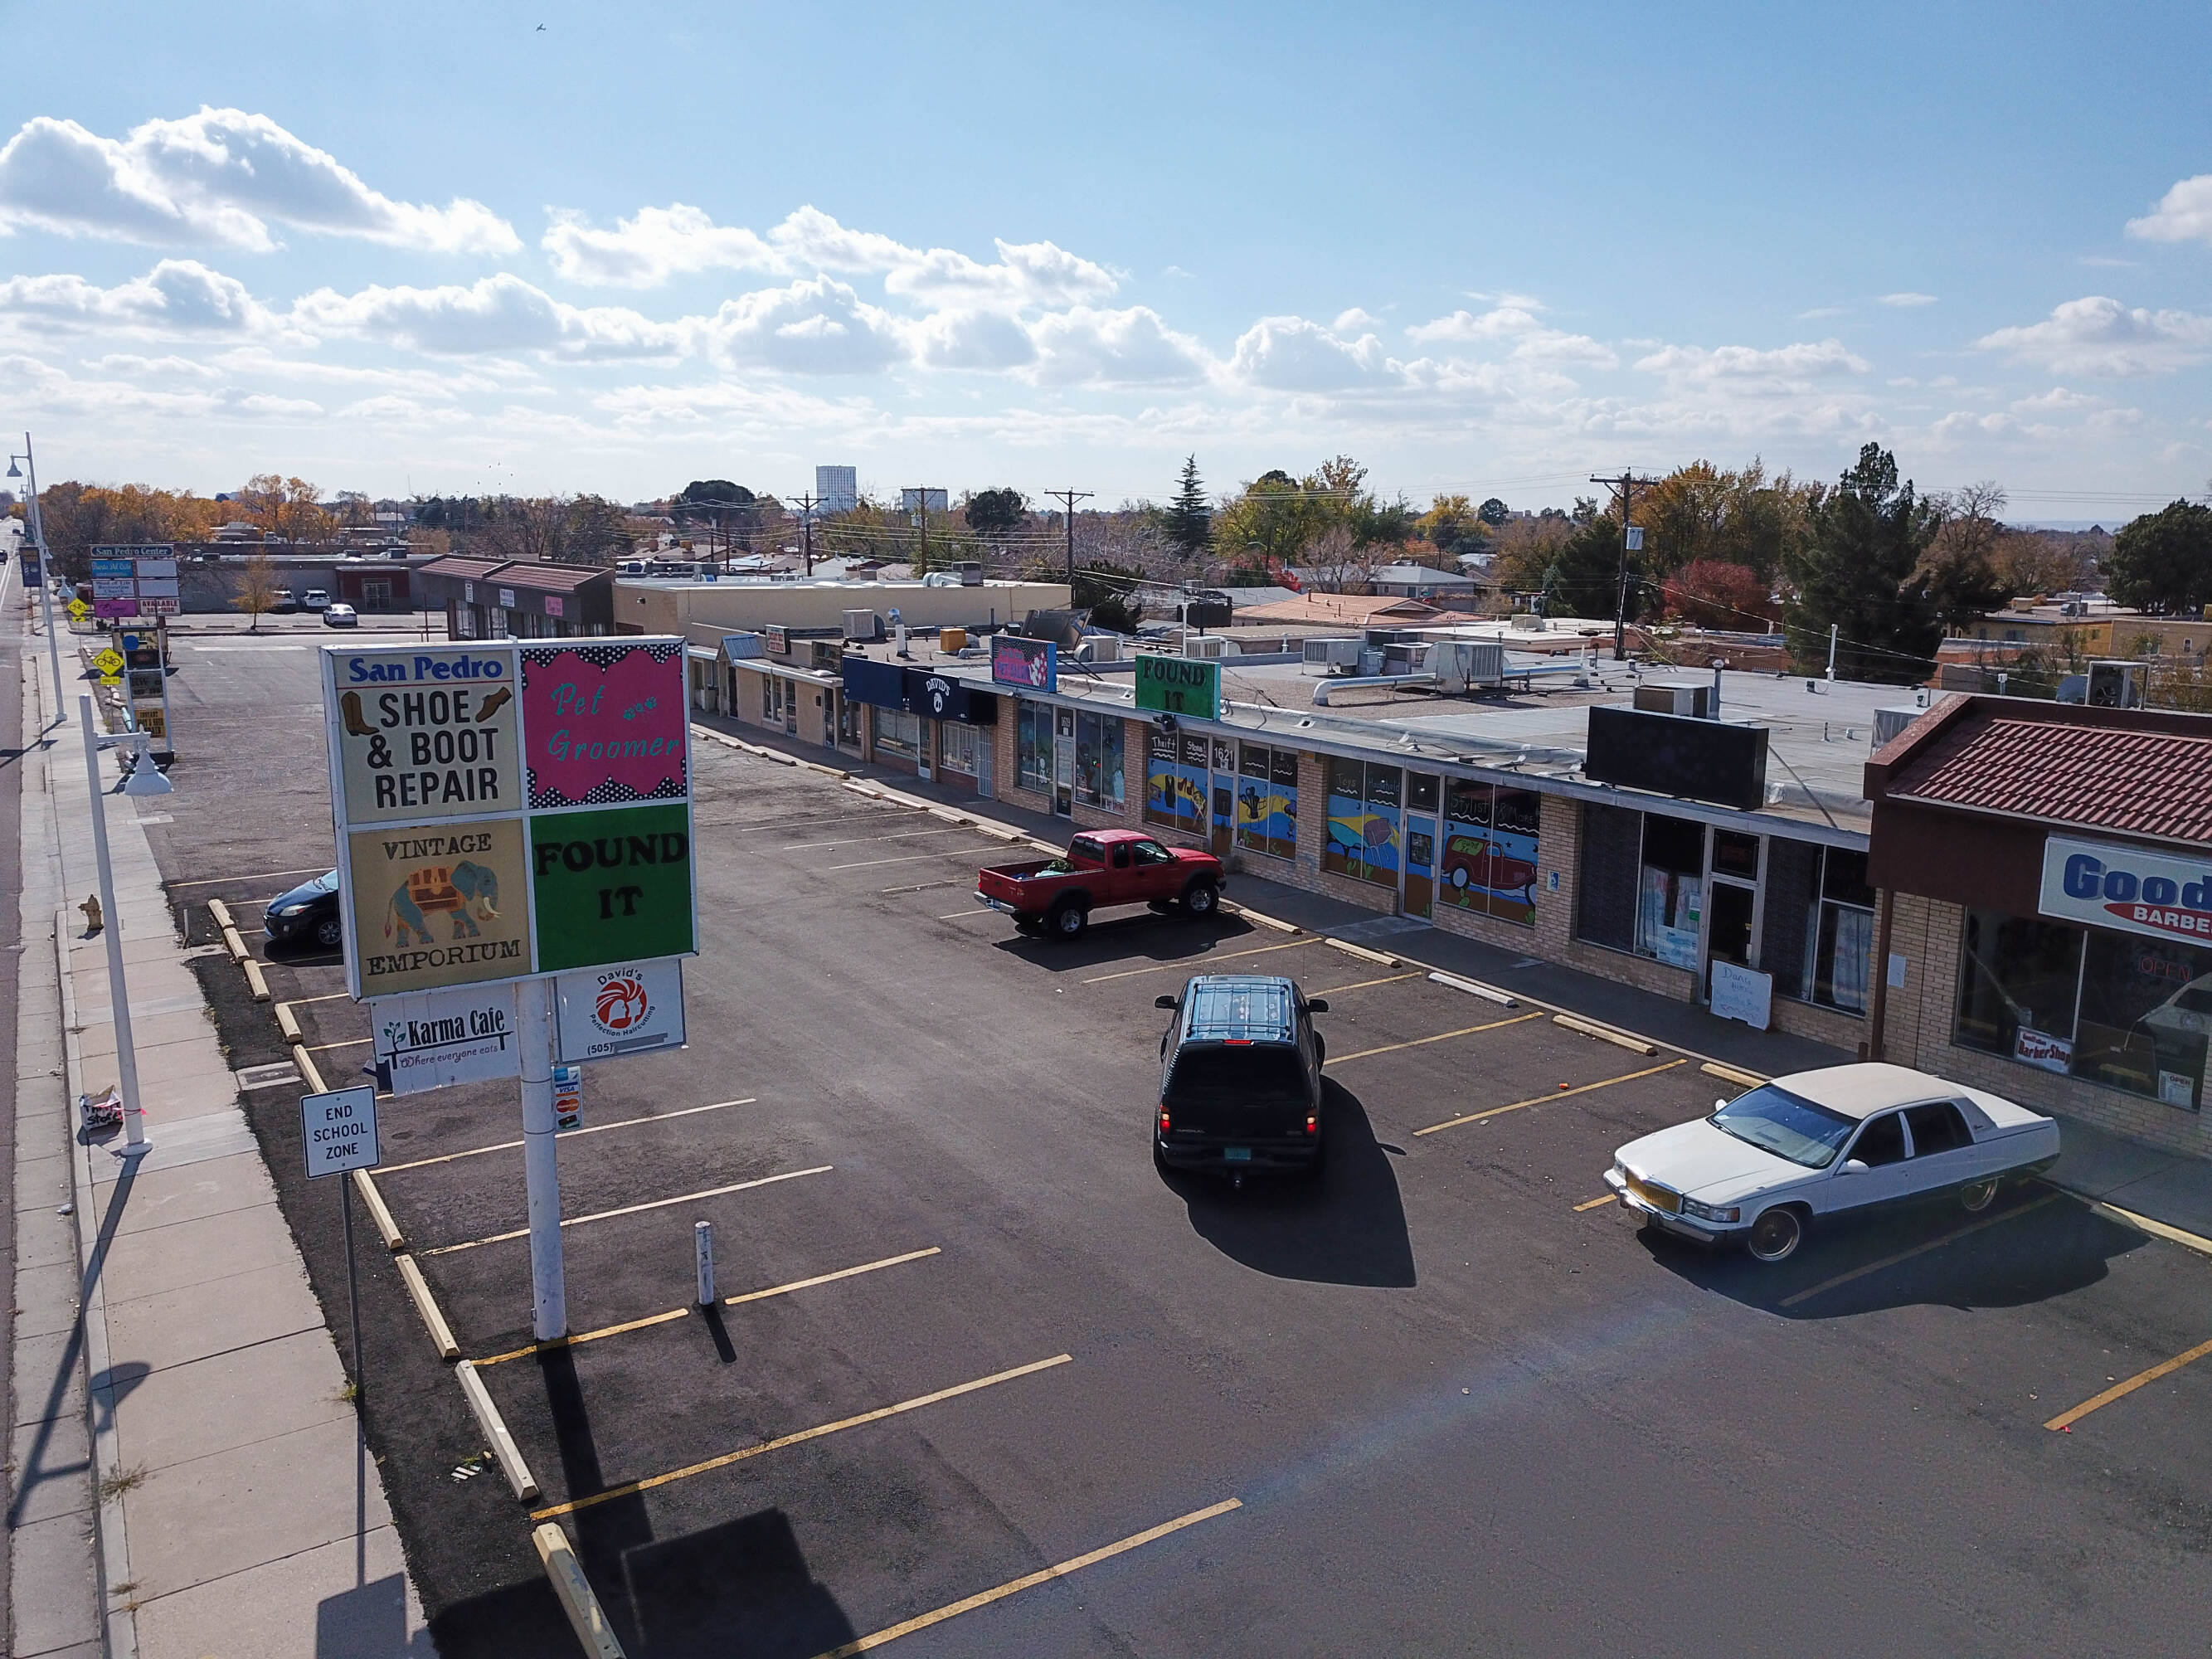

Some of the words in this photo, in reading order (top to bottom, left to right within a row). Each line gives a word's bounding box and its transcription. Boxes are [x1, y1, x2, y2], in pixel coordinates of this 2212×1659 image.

[141, 547, 168, 556] Center
[349, 657, 407, 682] San
[414, 654, 503, 680] Pedro
[1144, 659, 1206, 687] FOUND
[550, 683, 606, 716] Pet
[926, 677, 950, 697] DAVID'S
[1164, 689, 1184, 712] IT
[378, 690, 471, 728] SHOE
[367, 734, 394, 769] &
[411, 727, 498, 766] BOOT
[548, 728, 680, 761] Groomer
[1150, 736, 1177, 750] Thrift
[1213, 747, 1234, 761] 1621
[375, 767, 498, 809] REPAIR
[382, 833, 493, 861] VINTAGE
[533, 832, 689, 877] FOUND
[2064, 854, 2212, 912] Good
[598, 885, 644, 920] IT
[2132, 905, 2212, 934] BARBE
[366, 939, 522, 976] EMPORIUM
[2141, 956, 2190, 983] OPEN
[597, 967, 644, 986] David's
[407, 1015, 466, 1047] Karma
[469, 1006, 505, 1037] Cafe
[590, 1013, 621, 1037] Perfection
[623, 1005, 656, 1036] Haircutting
[400, 1054, 436, 1068] Where
[437, 1047, 478, 1063] everyone
[479, 1044, 498, 1057] eats
[587, 1041, 613, 1056] (505)
[325, 1105, 352, 1121] END
[314, 1121, 368, 1142] SCHOOL
[325, 1142, 359, 1160] ZONE
